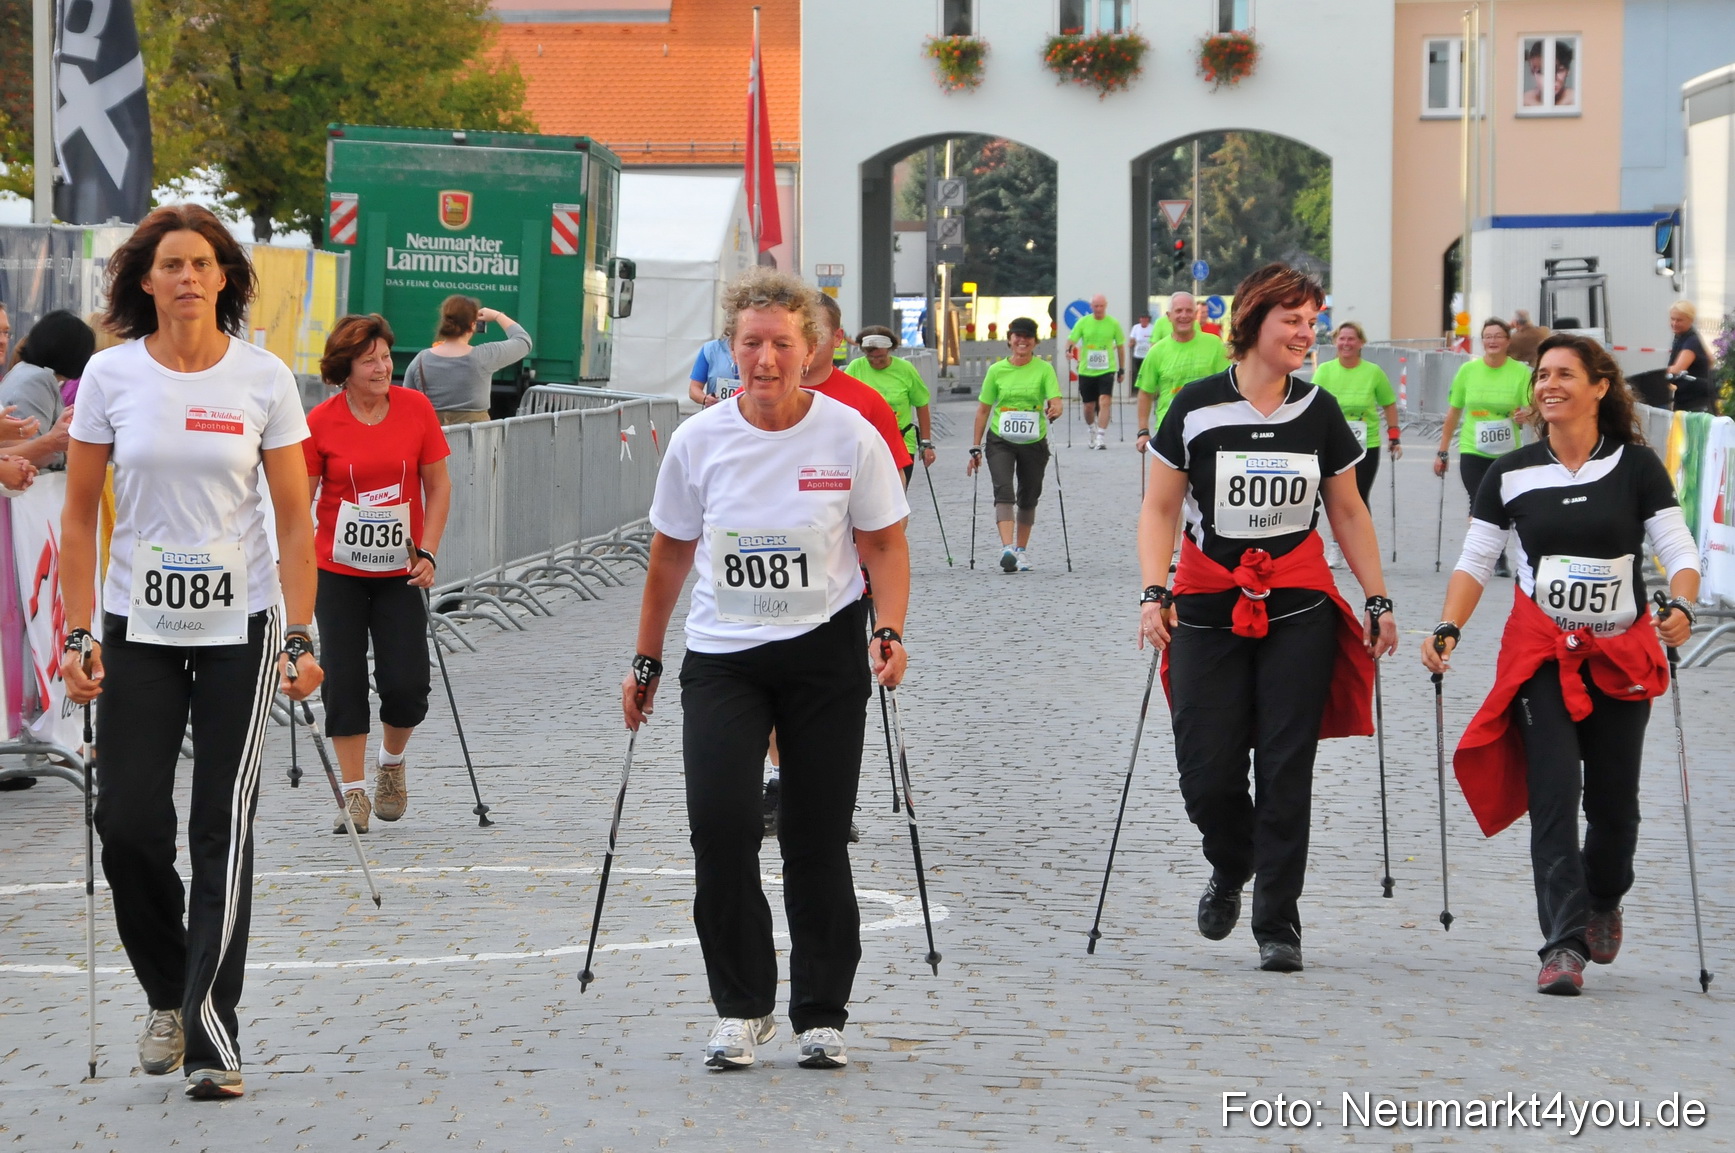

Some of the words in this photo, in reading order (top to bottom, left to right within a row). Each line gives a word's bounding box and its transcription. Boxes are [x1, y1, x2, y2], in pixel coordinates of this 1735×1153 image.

[406, 232, 503, 253] Neumarkter
[386, 247, 519, 276] Lammsbräu
[385, 278, 404, 286] DAS
[406, 279, 430, 288] FEINE
[432, 279, 497, 291] ÖKOLOGISCHE
[499, 284, 519, 292] BIER
[209, 411, 242, 421] Wildbad
[195, 421, 236, 431] Apotheke
[1003, 420, 1035, 434] 8067
[1481, 428, 1511, 443] 8069
[1246, 458, 1289, 468] BOCK
[819, 469, 850, 478] Wildbad
[807, 481, 844, 489] Apotheke
[1228, 475, 1308, 508] 8000
[369, 491, 389, 502] DEHN
[359, 510, 392, 519] BOCK
[1249, 512, 1283, 528] Heidi
[344, 521, 403, 548] 8036
[738, 535, 787, 546] BOCK
[162, 552, 211, 564] BOCK
[351, 551, 395, 564] Melanie
[724, 553, 809, 589] 8081
[1569, 563, 1612, 575] BOCK
[145, 570, 234, 609] 8084
[1548, 579, 1623, 614] 8057
[753, 595, 788, 618] Helga
[156, 614, 205, 631] Andrea
[640, 659, 652, 684] LEKI
